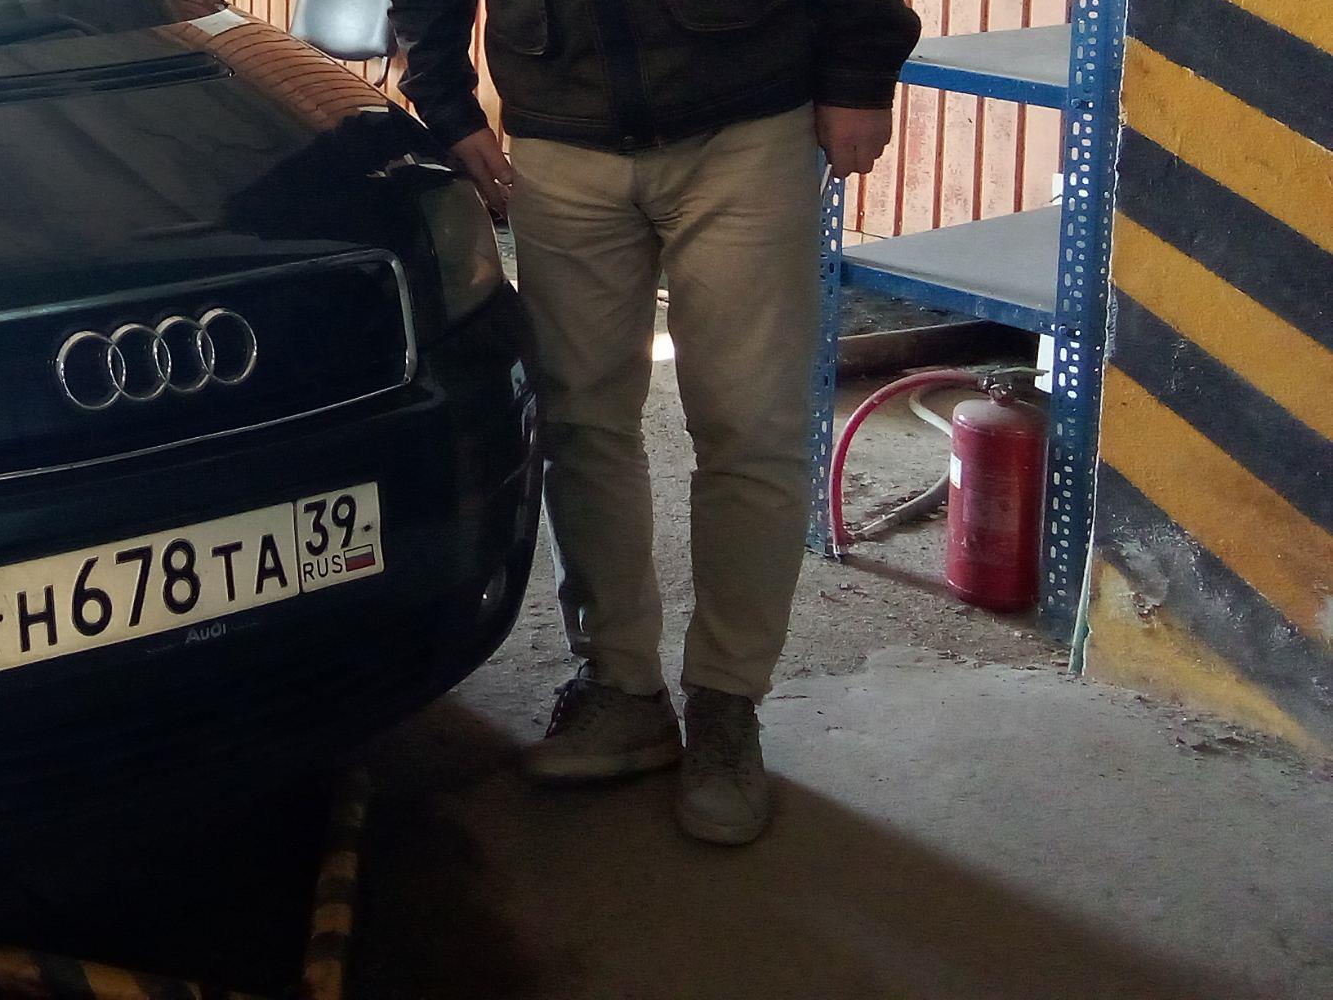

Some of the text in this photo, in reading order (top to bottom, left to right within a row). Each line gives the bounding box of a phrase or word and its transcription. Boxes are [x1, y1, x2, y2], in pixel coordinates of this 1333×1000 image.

[303, 494, 357, 556] 39
[302, 555, 343, 582] RUS
[17, 533, 288, 652] Н678ТА
[185, 622, 227, 645] Audi
